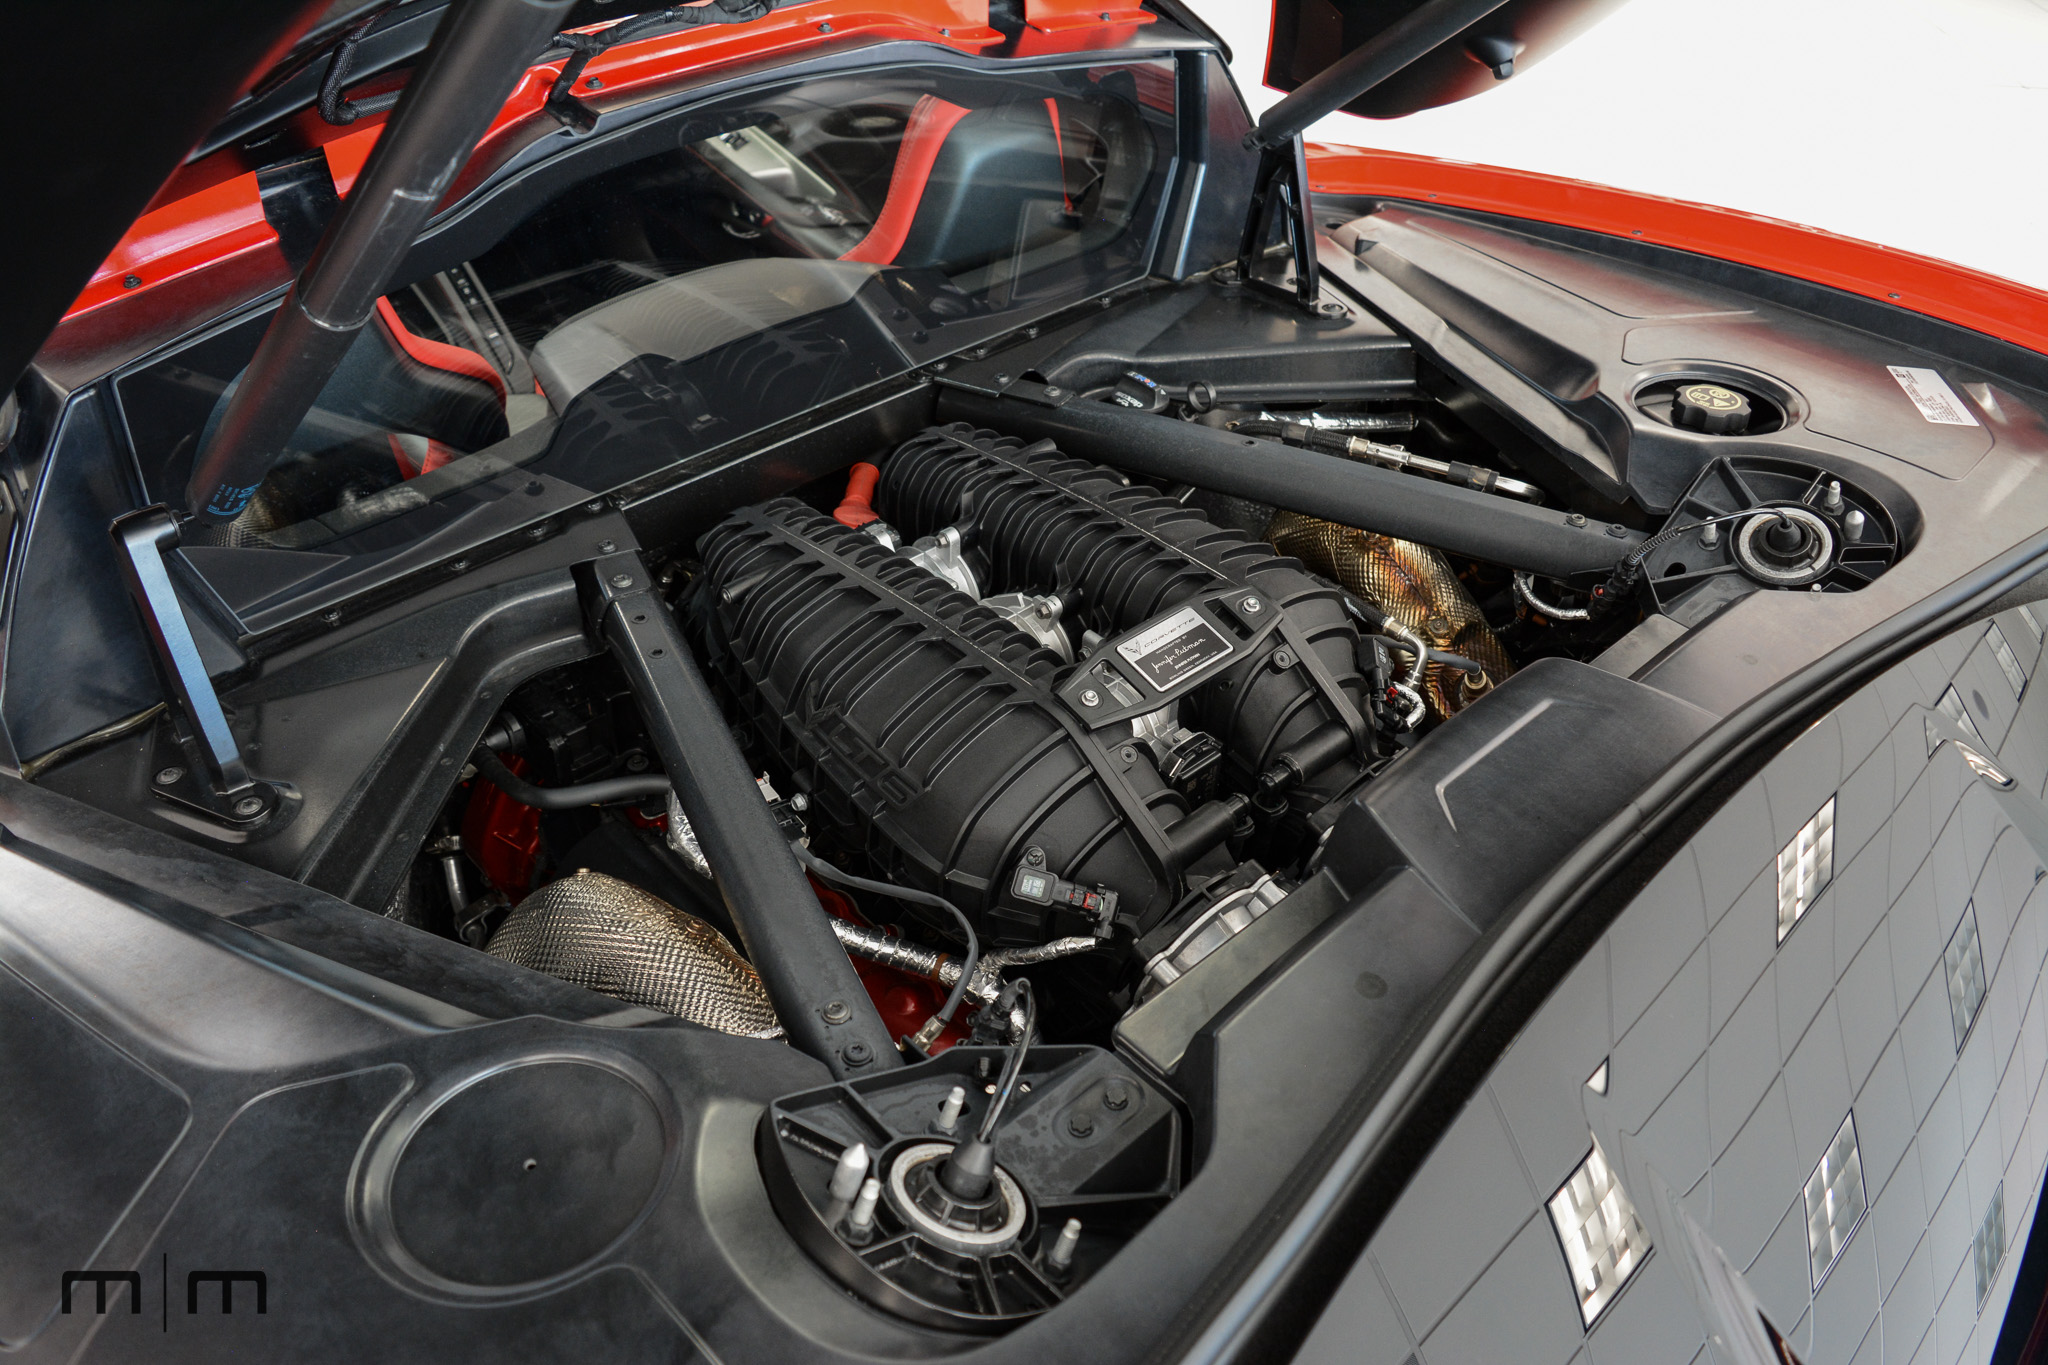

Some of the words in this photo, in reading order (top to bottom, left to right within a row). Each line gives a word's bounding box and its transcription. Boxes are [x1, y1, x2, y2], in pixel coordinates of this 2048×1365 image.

[1144, 617, 1195, 648] CORVETTE
[1151, 654, 1178, 674] Jennifer
[828, 722, 923, 809] LT6
